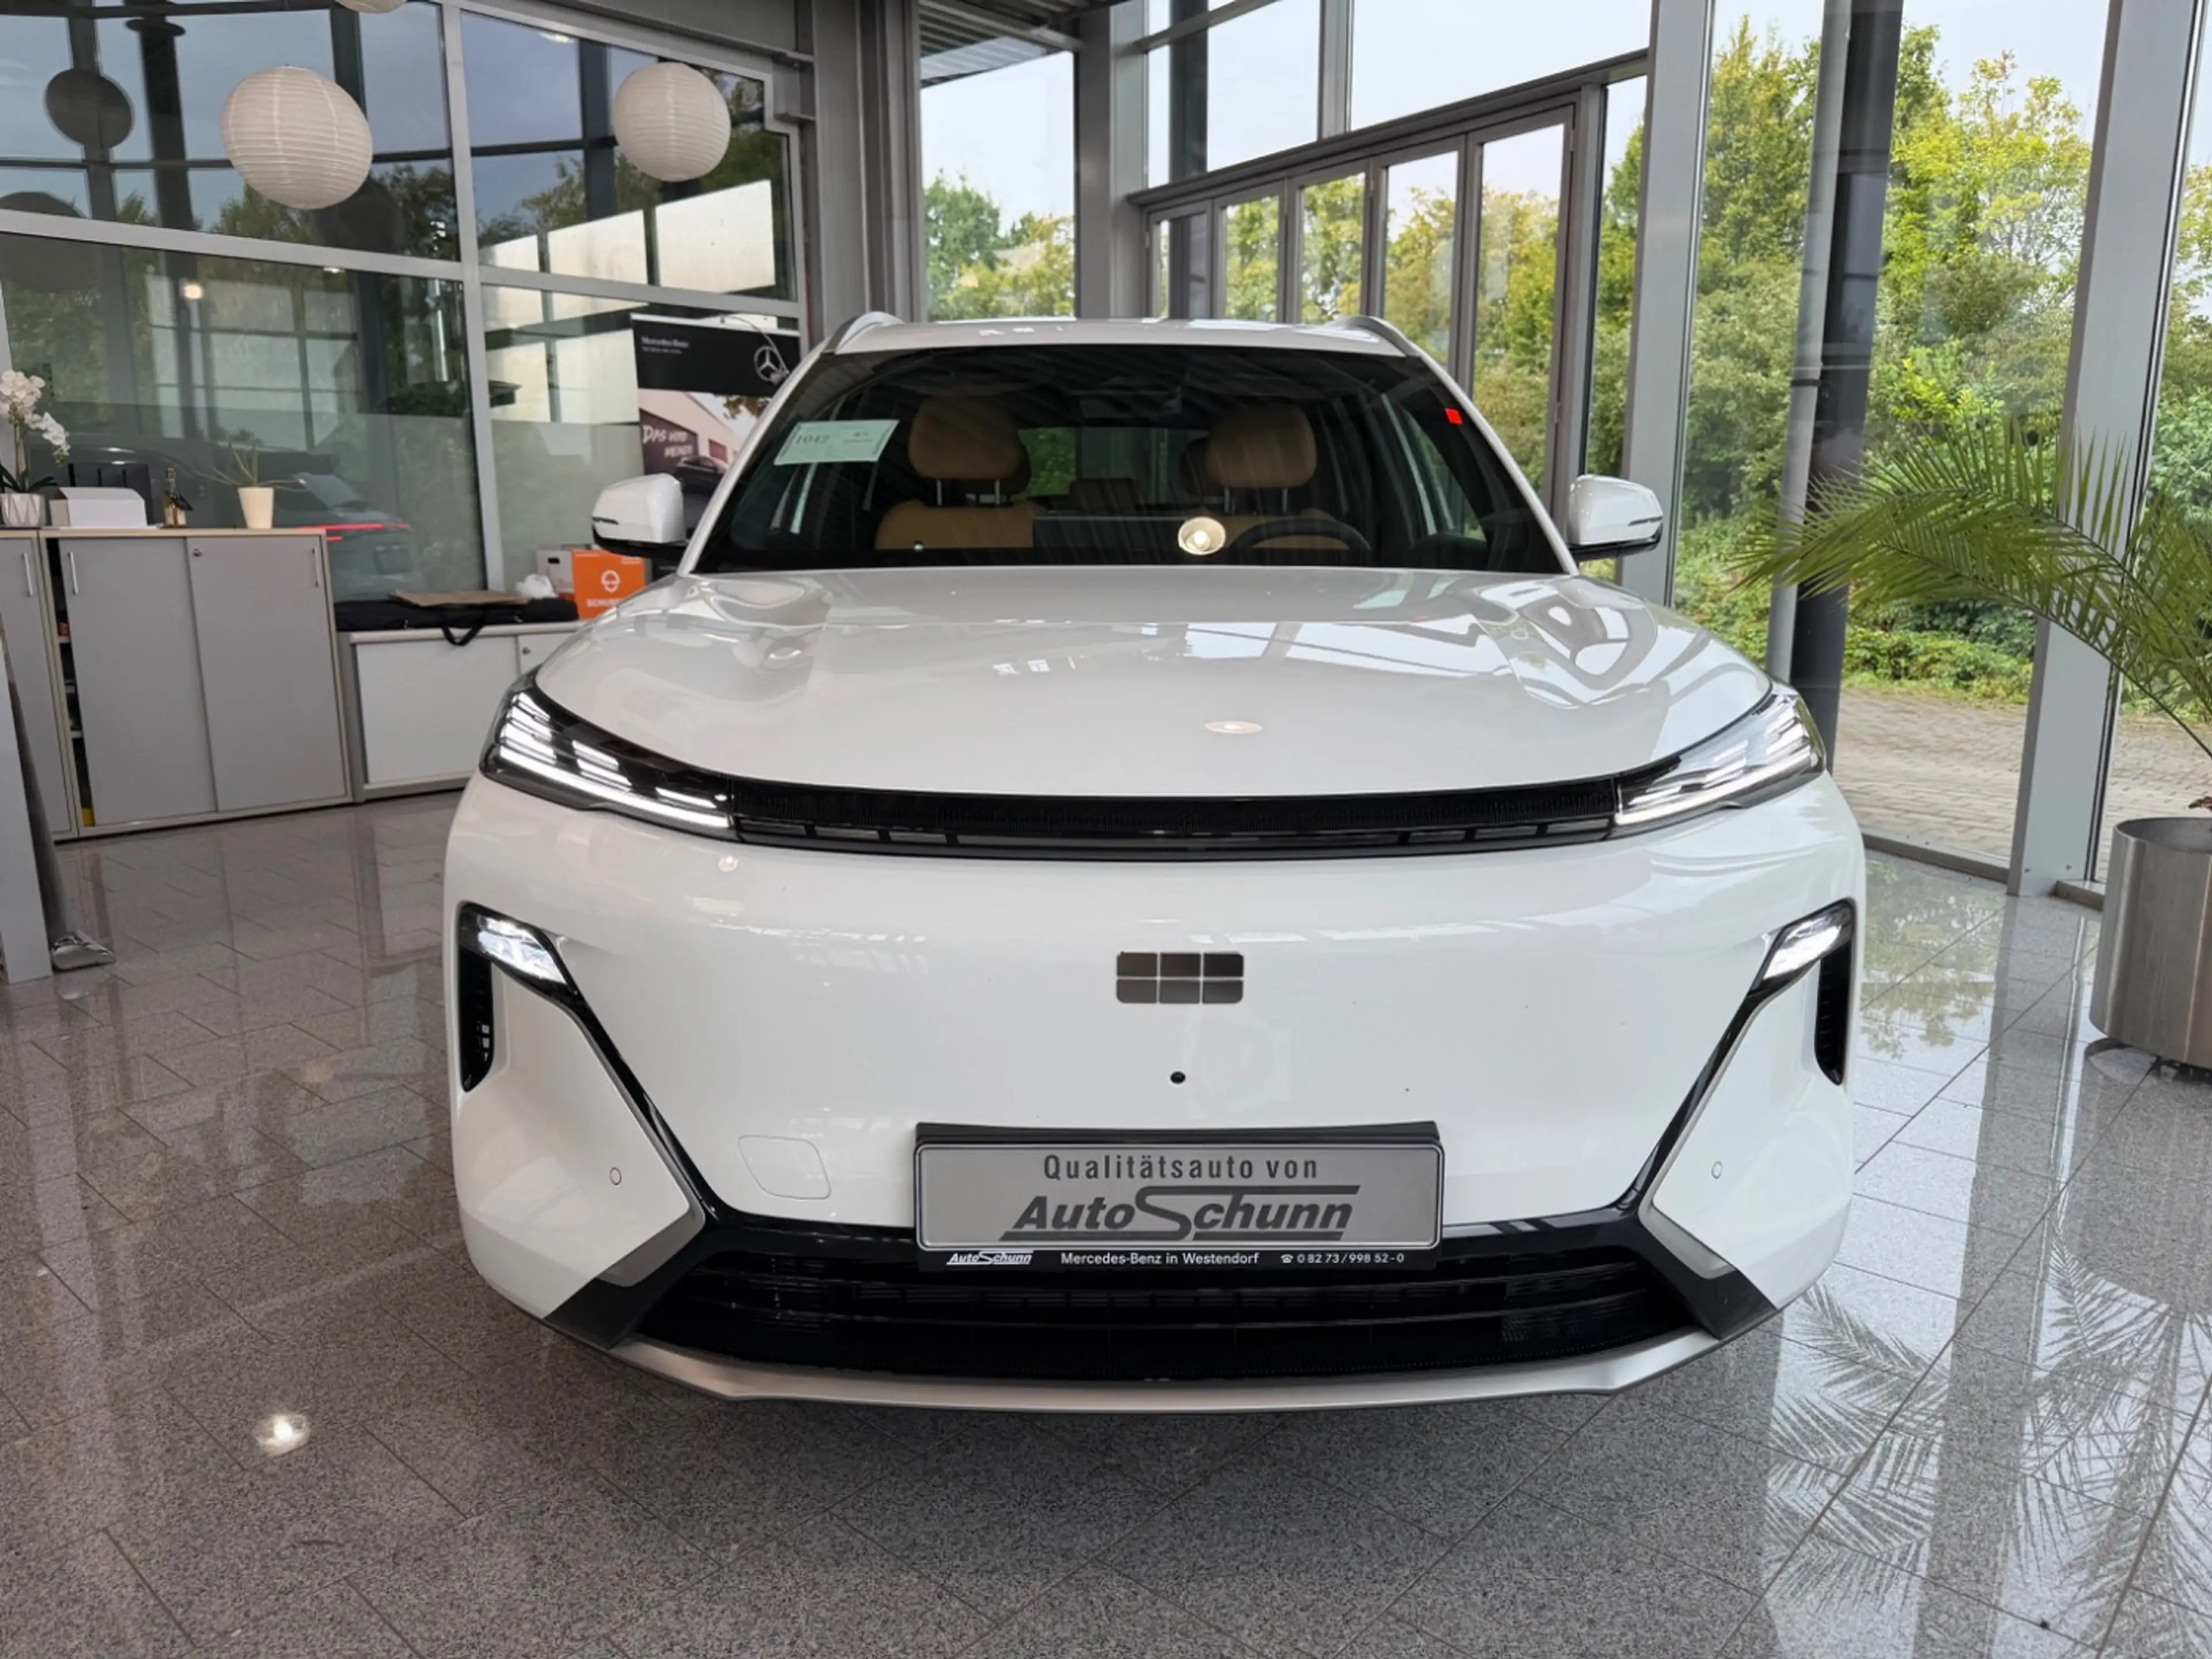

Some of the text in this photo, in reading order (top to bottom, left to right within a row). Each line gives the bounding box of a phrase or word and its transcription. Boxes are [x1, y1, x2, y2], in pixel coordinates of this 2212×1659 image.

[1043, 1154, 1318, 1180] Qualitätsauto von
[1060, 1252, 1260, 1264] Mercedes-Benz in Westendorf
